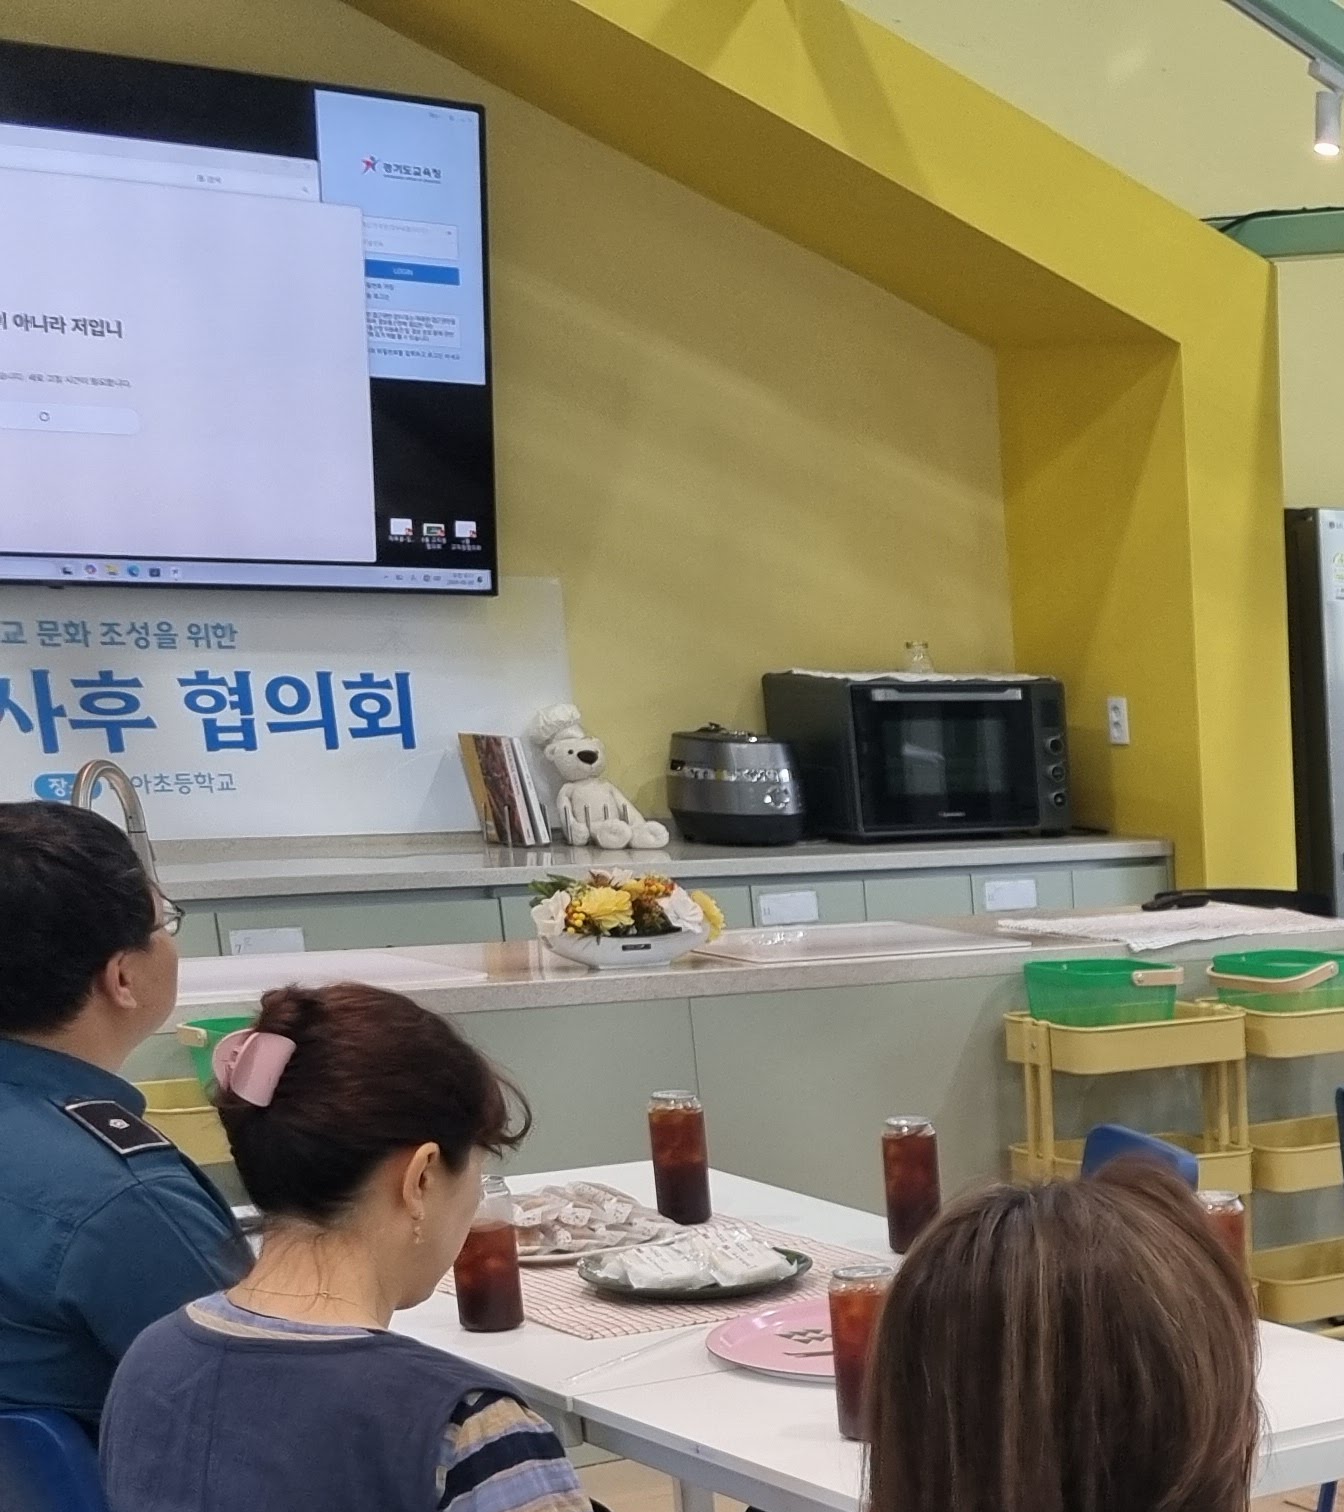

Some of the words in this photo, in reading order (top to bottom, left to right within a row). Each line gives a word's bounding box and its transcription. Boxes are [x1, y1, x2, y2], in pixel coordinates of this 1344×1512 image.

[12, 313, 66, 334] 아니라
[71, 317, 122, 339] 저입니
[1, 620, 28, 645] 교
[36, 619, 91, 648] 문화
[100, 620, 179, 650] 조성을
[186, 622, 239, 650] 위한
[0, 668, 158, 754] 사후
[176, 669, 417, 753] 협의회
[108, 772, 237, 795] 아초등학교
